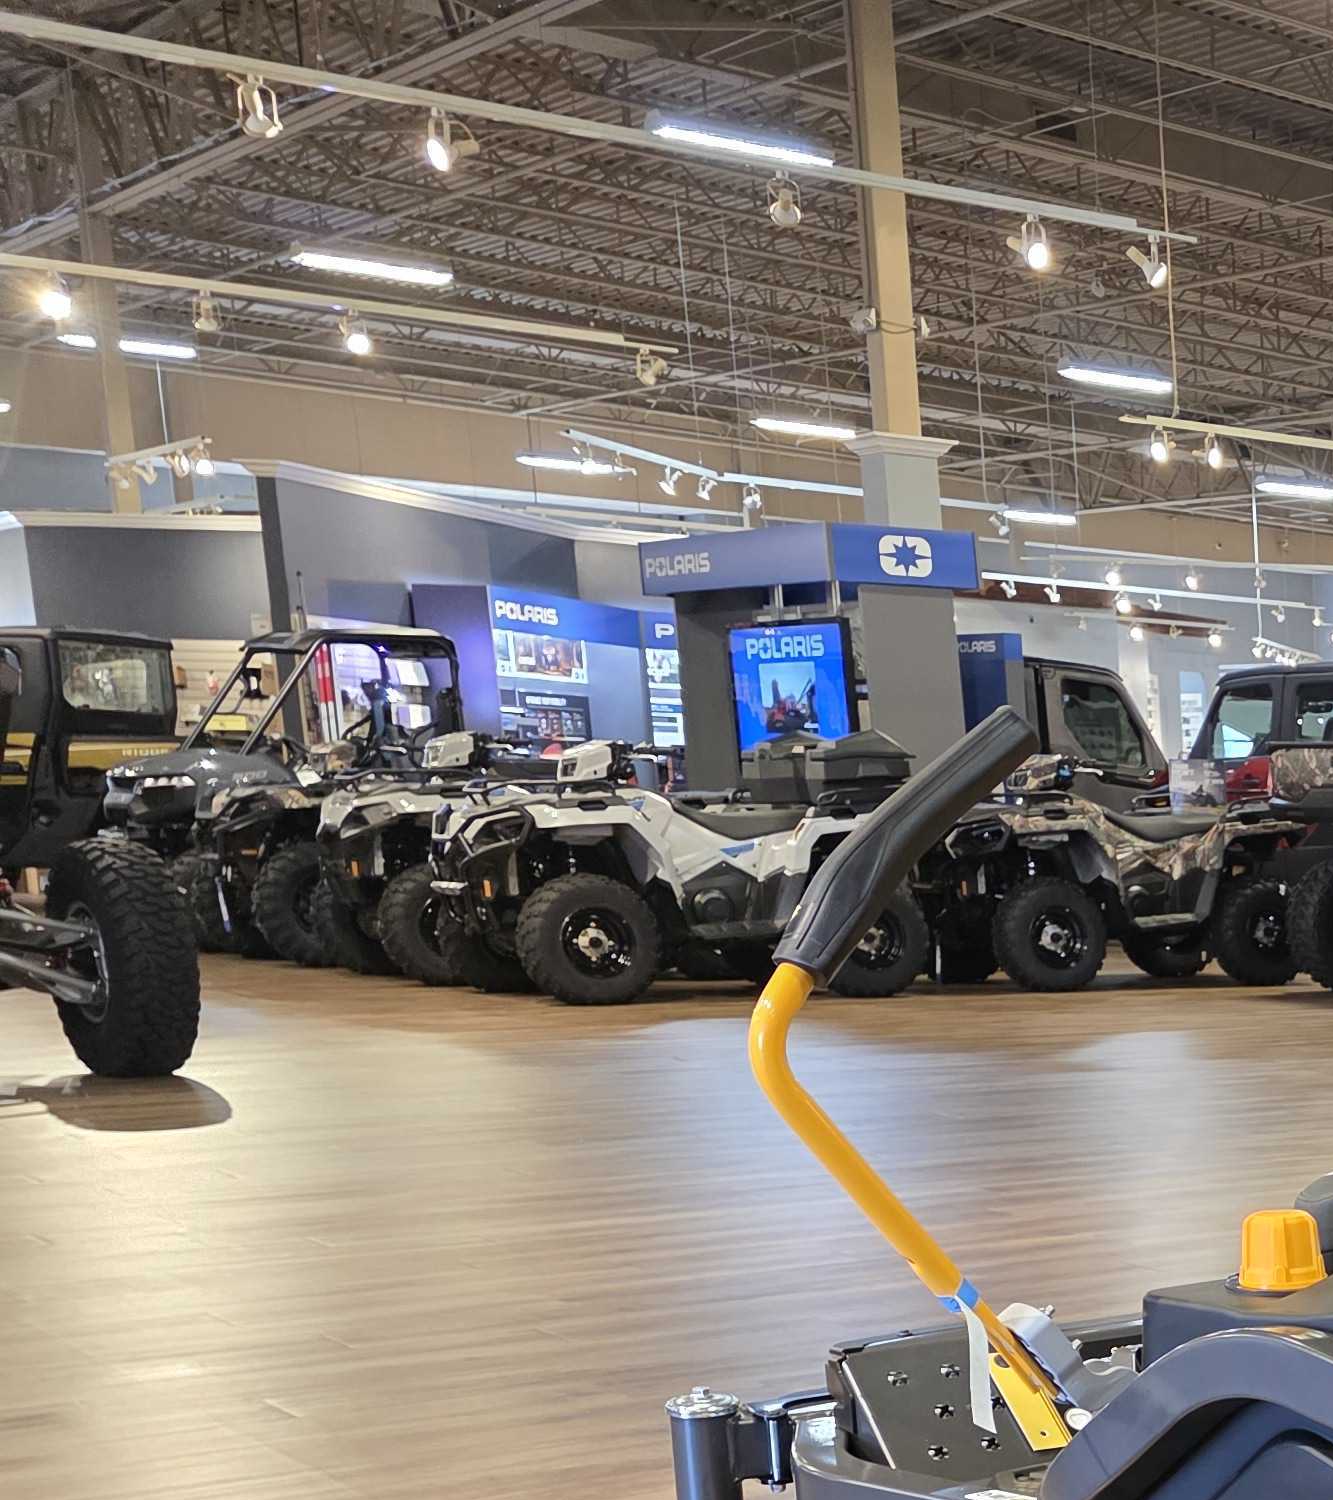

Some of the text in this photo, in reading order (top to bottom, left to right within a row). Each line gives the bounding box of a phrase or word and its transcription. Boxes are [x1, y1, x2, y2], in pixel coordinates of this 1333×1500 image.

[645, 552, 711, 578] POLARIS
[494, 600, 559, 626] POLARIS
[745, 634, 825, 660] POLARIS
[959, 640, 997, 653] OLARIS
